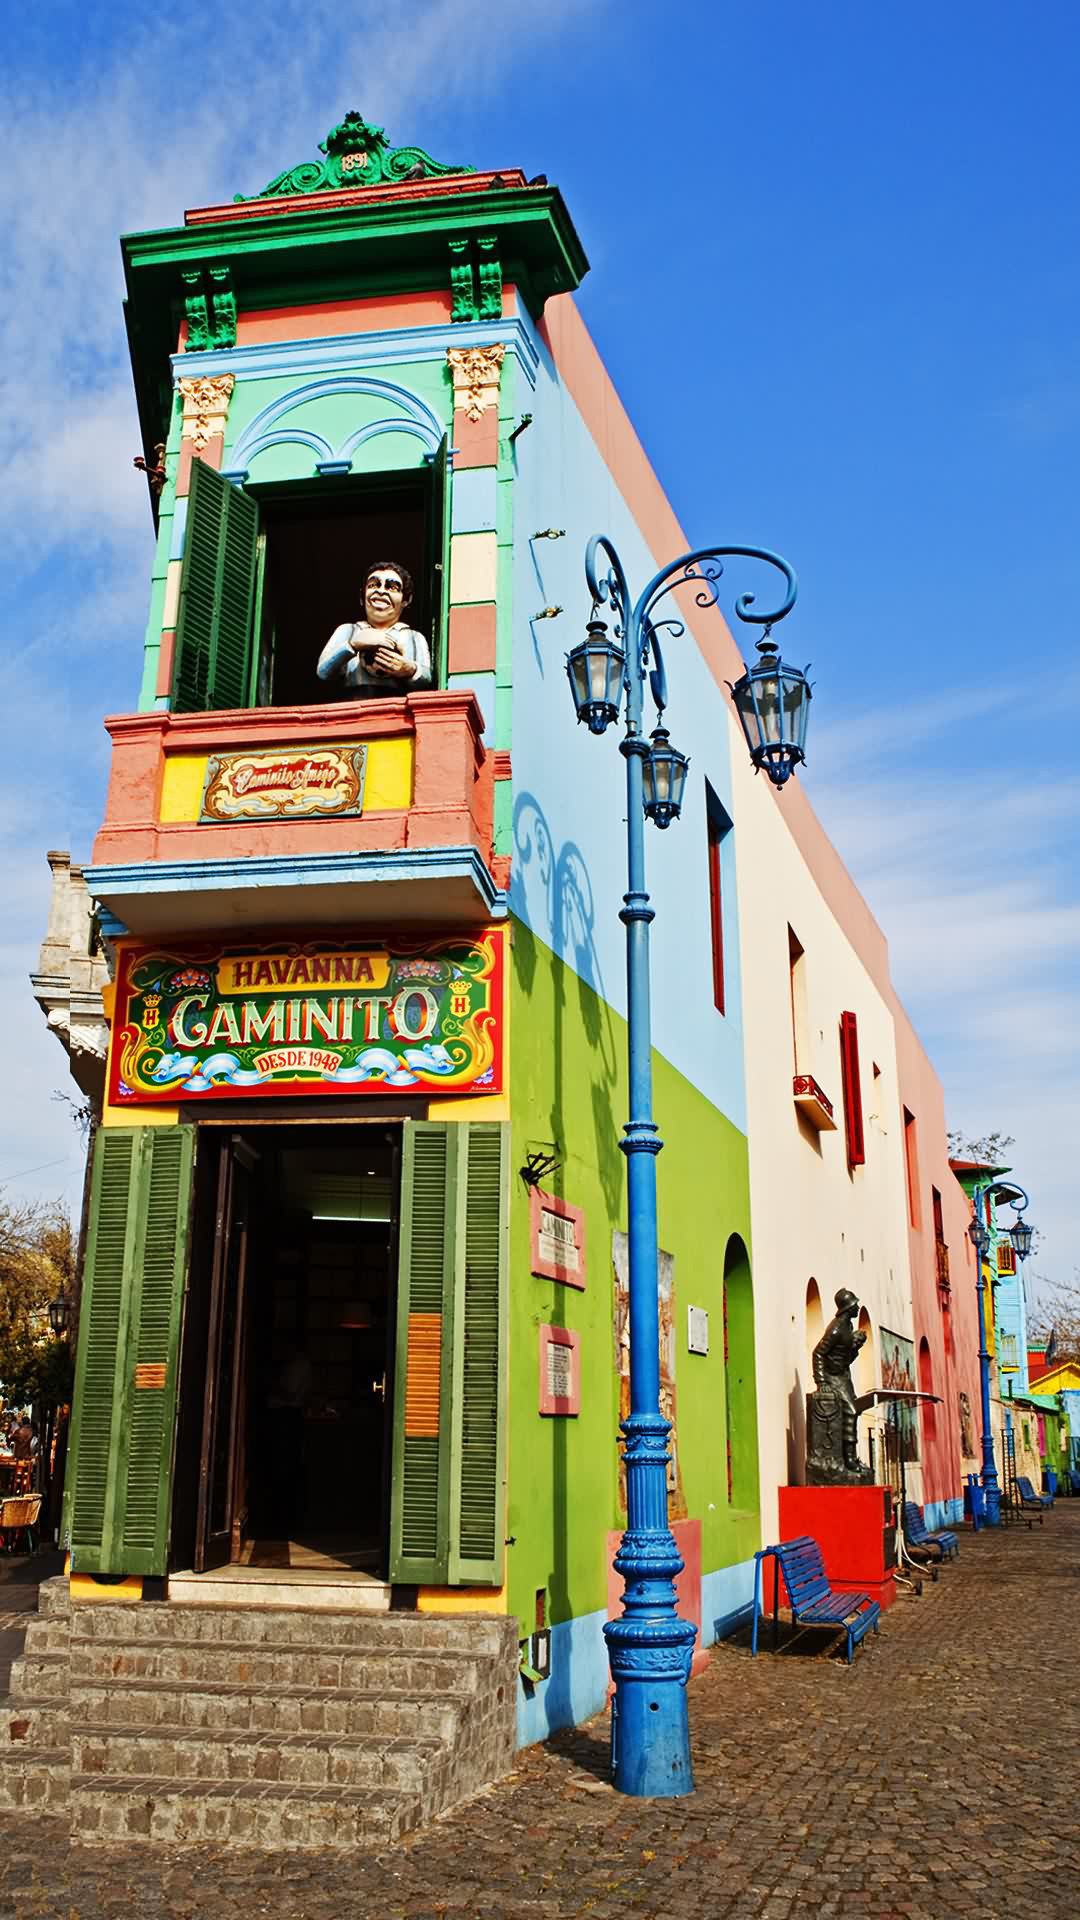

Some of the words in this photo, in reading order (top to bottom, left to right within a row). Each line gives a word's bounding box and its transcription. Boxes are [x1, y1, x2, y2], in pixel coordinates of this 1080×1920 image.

[342, 152, 368, 172] 1891
[232, 957, 375, 988] HAVANNA
[454, 997, 466, 1013] H
[145, 1009, 157, 1025] H
[171, 986, 440, 1048] CAMINITO
[257, 1051, 307, 1073] DESDE
[308, 1051, 340, 1072] 1948
